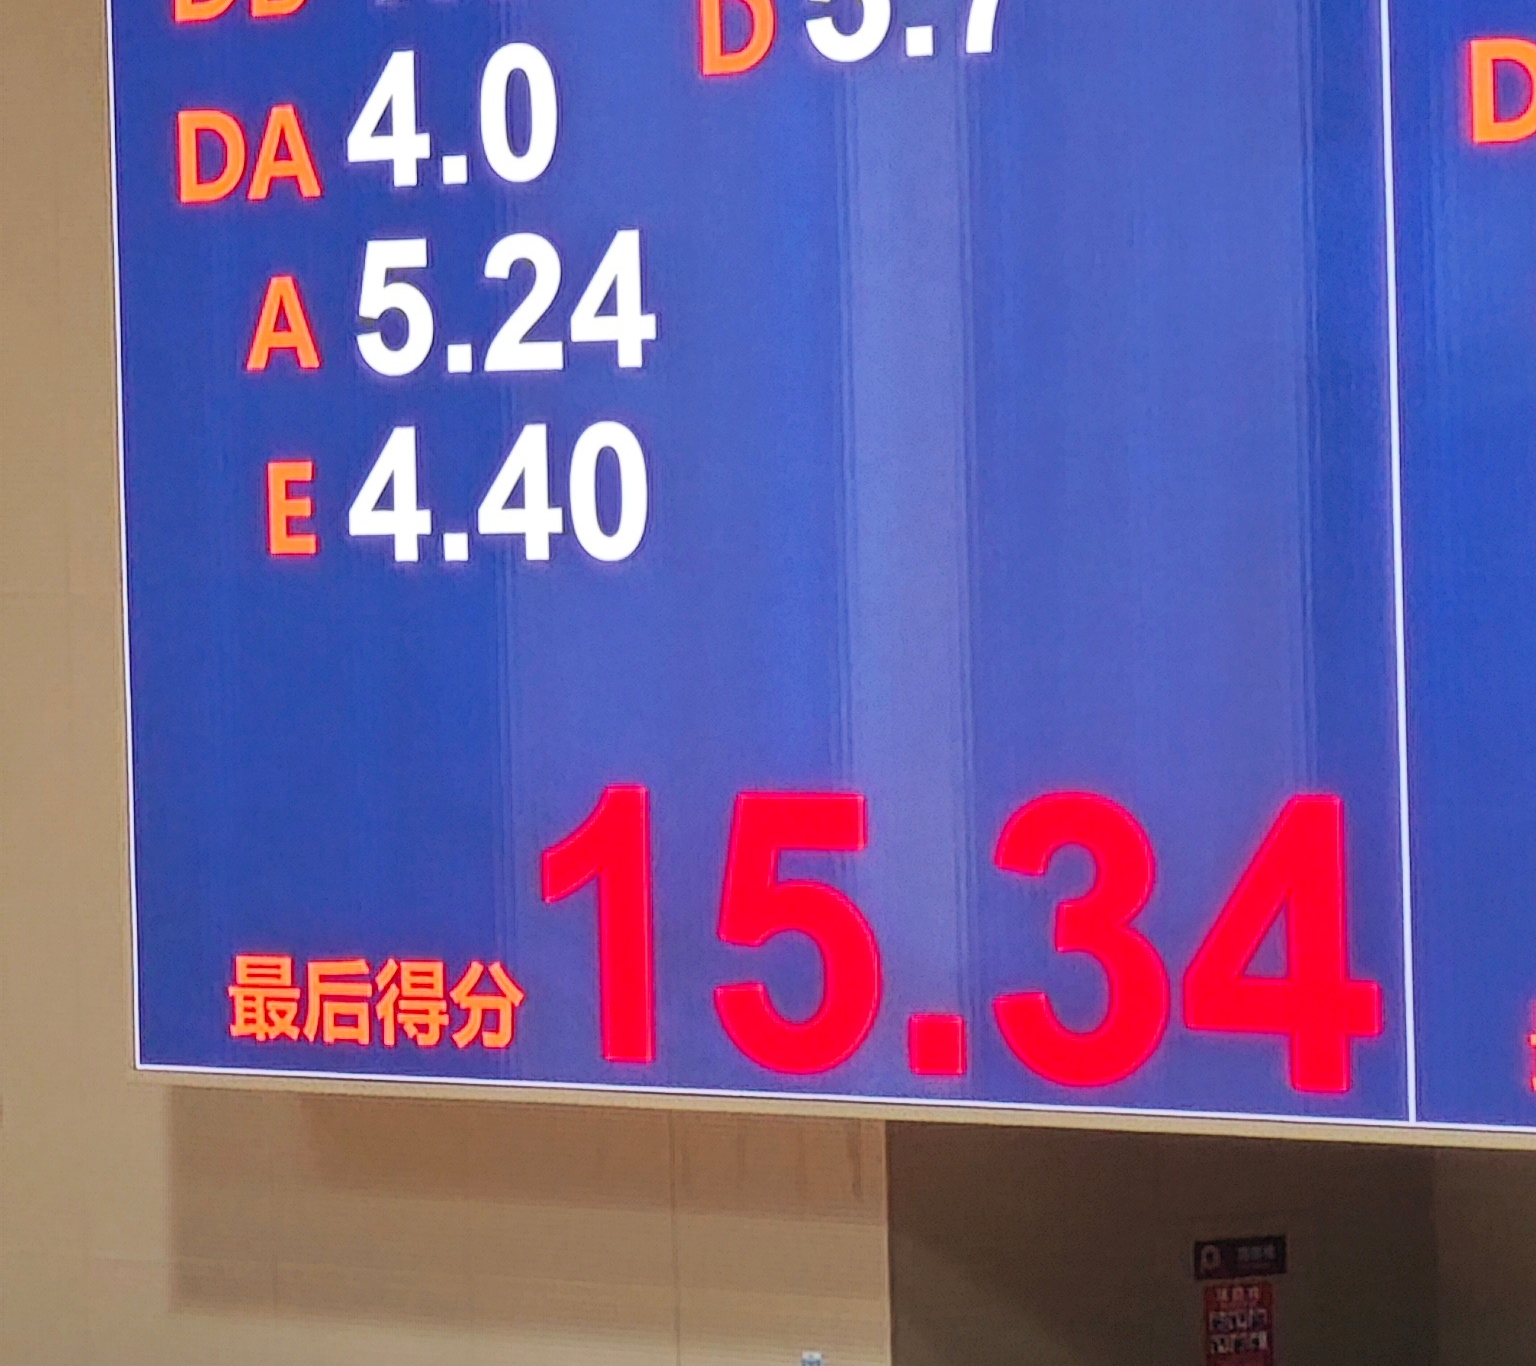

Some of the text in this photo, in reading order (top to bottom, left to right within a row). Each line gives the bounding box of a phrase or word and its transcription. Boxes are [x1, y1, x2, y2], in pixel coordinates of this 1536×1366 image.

[177, 43, 556, 204] DA 4.0
[247, 230, 656, 375] A 5.24
[268, 422, 647, 561] E 4.40
[228, 785, 1382, 1093] 最后得分 15.34
